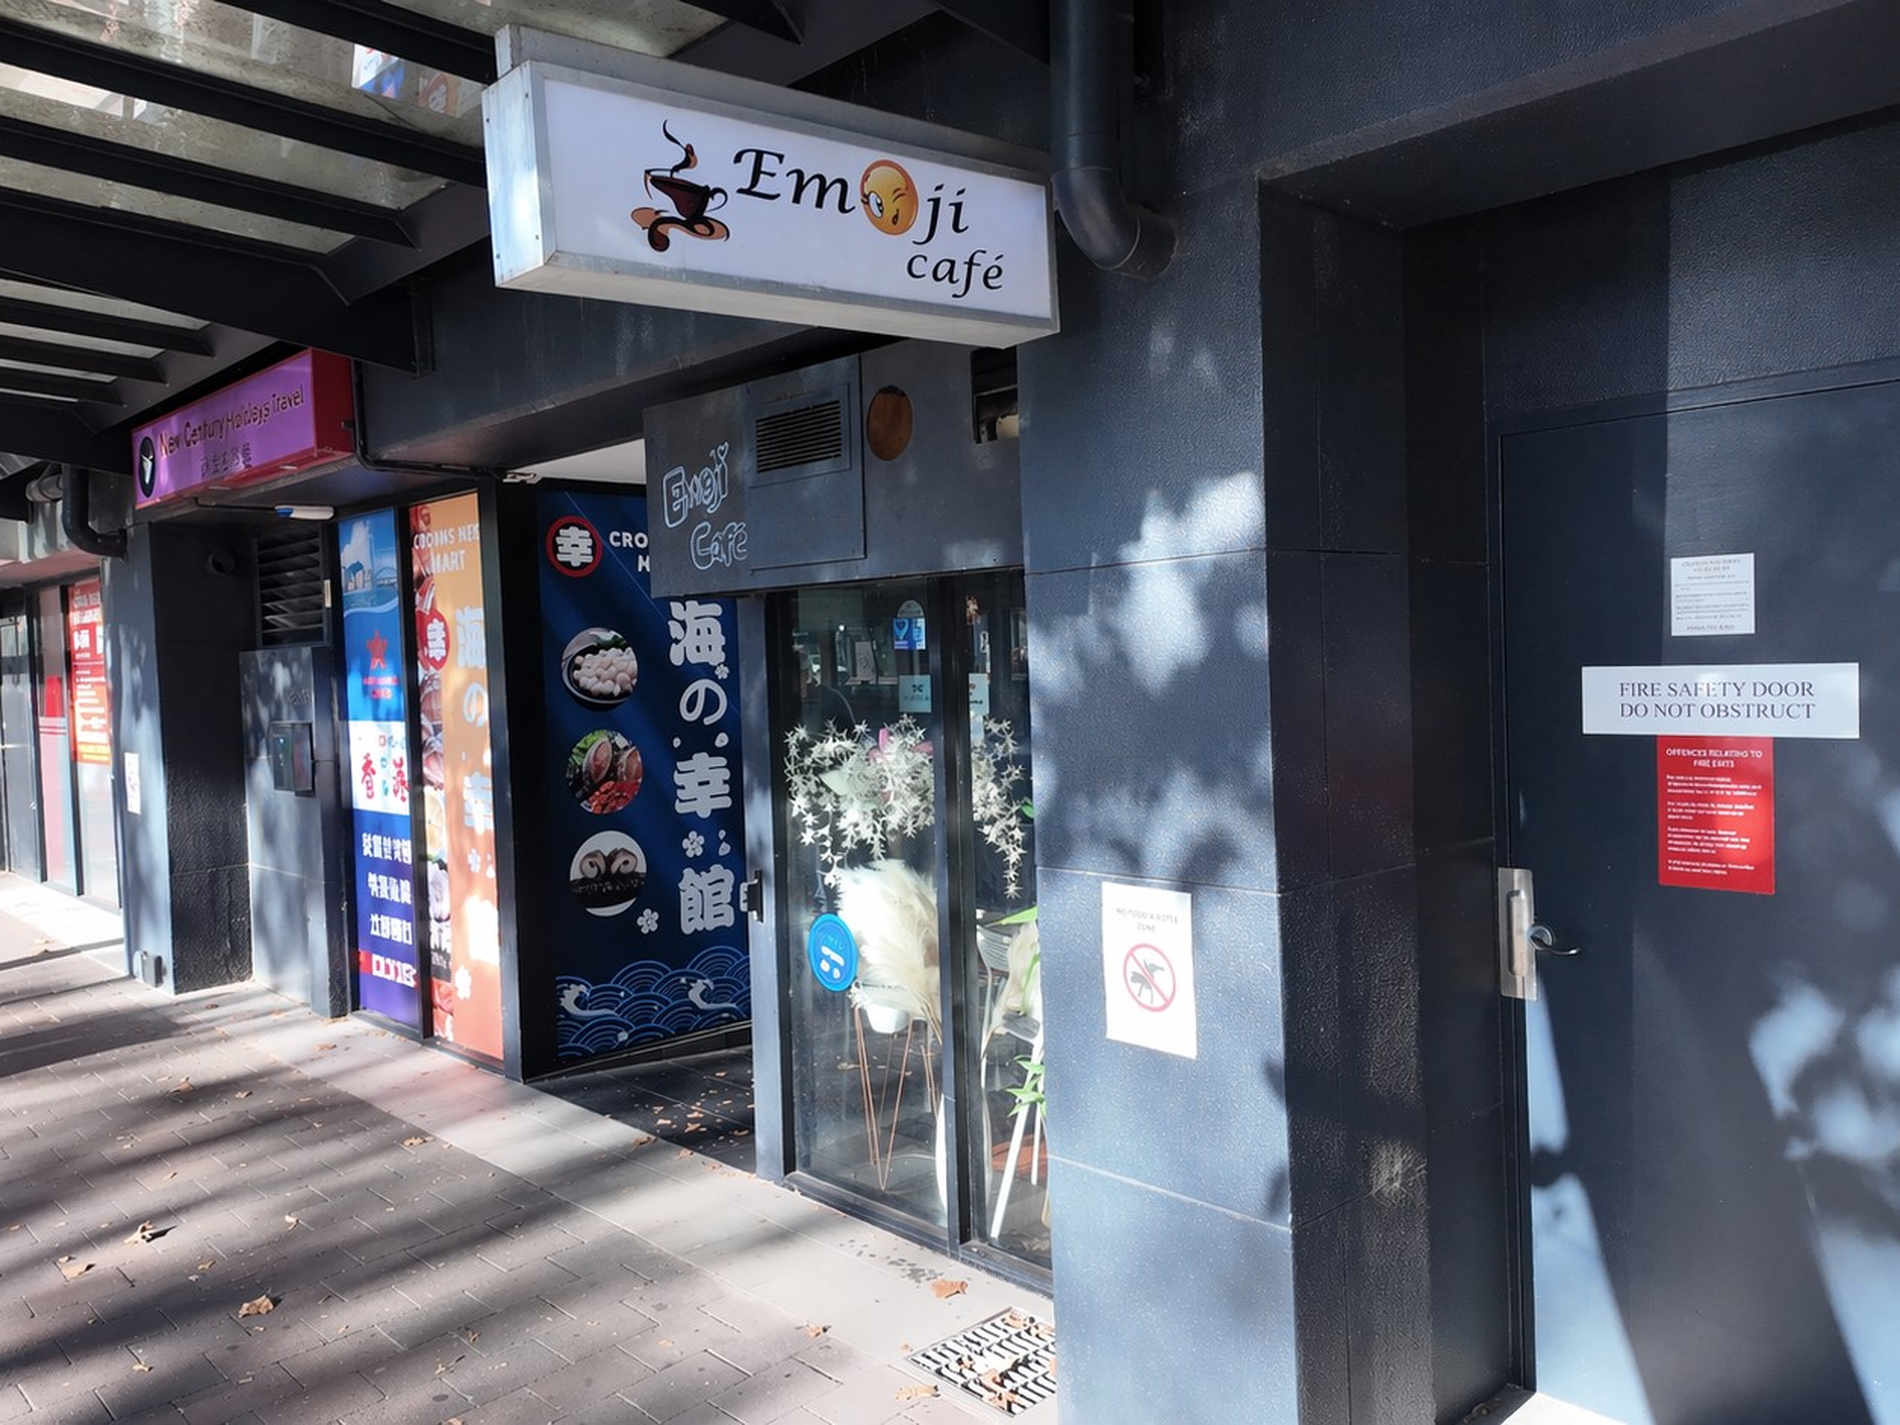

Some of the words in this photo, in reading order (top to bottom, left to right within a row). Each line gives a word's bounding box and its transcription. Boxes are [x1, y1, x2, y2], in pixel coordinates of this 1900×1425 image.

[906, 249, 1004, 299] café
[159, 429, 185, 457] New
[184, 417, 226, 449] Century
[271, 384, 305, 415] Travel
[1619, 682, 1662, 698] FIRE
[1667, 681, 1746, 698] SAFETY
[1752, 681, 1815, 698] DOOR
[1620, 703, 1648, 718] DO
[1654, 703, 1696, 718] NOT
[1700, 702, 1816, 719] OBSTRUCT
[668, 601, 735, 935] 海の幸館
[1750, 750, 1763, 758] TO
